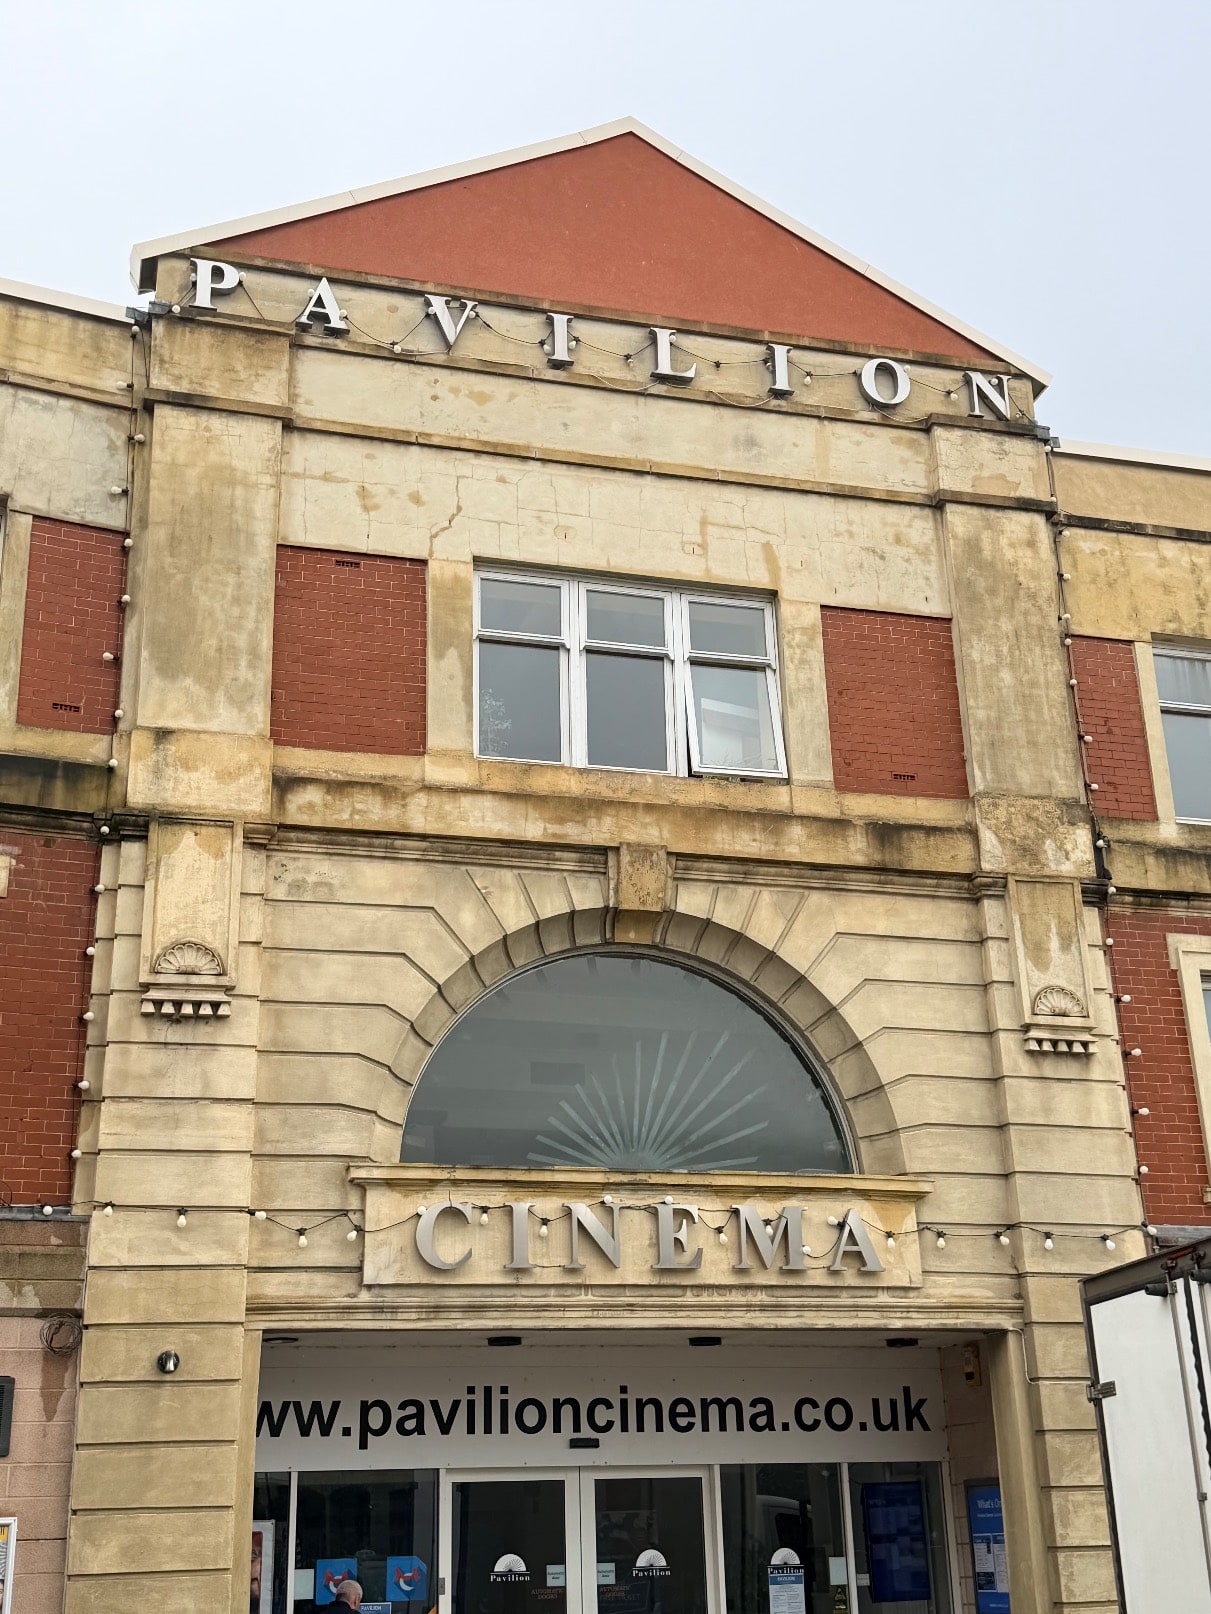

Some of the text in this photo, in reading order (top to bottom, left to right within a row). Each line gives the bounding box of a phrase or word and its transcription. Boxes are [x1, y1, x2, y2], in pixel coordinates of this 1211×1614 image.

[190, 258, 1012, 421] PAVILION
[415, 1201, 886, 1273] CINEMA
[632, 1569, 671, 1577] Pavilion
[768, 1567, 805, 1575] Pavilion
